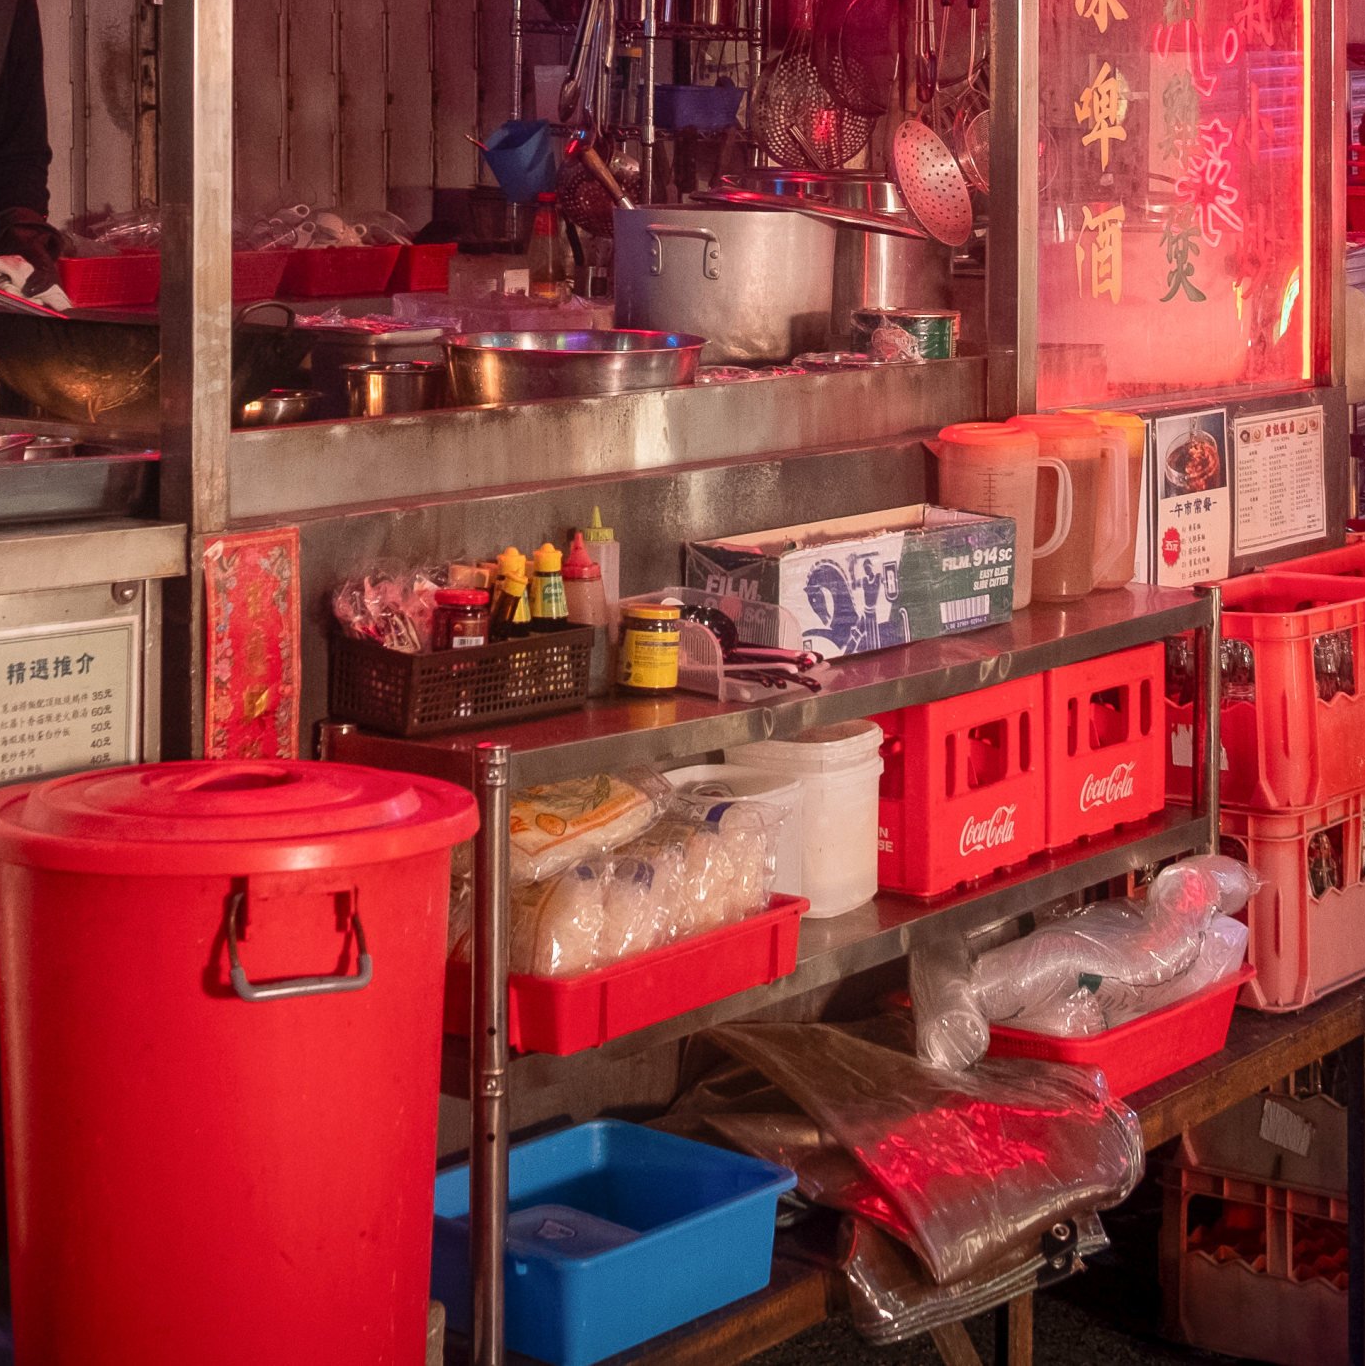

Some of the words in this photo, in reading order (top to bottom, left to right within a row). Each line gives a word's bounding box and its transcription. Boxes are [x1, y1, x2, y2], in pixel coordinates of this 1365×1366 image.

[973, 546, 997, 566] 914
[998, 547, 1013, 562] SC
[6, 652, 95, 686] 精選推介
[91, 688, 113, 702] 35元
[91, 704, 113, 718] 60元
[90, 720, 113, 734] 50元
[90, 736, 112, 750] 40元
